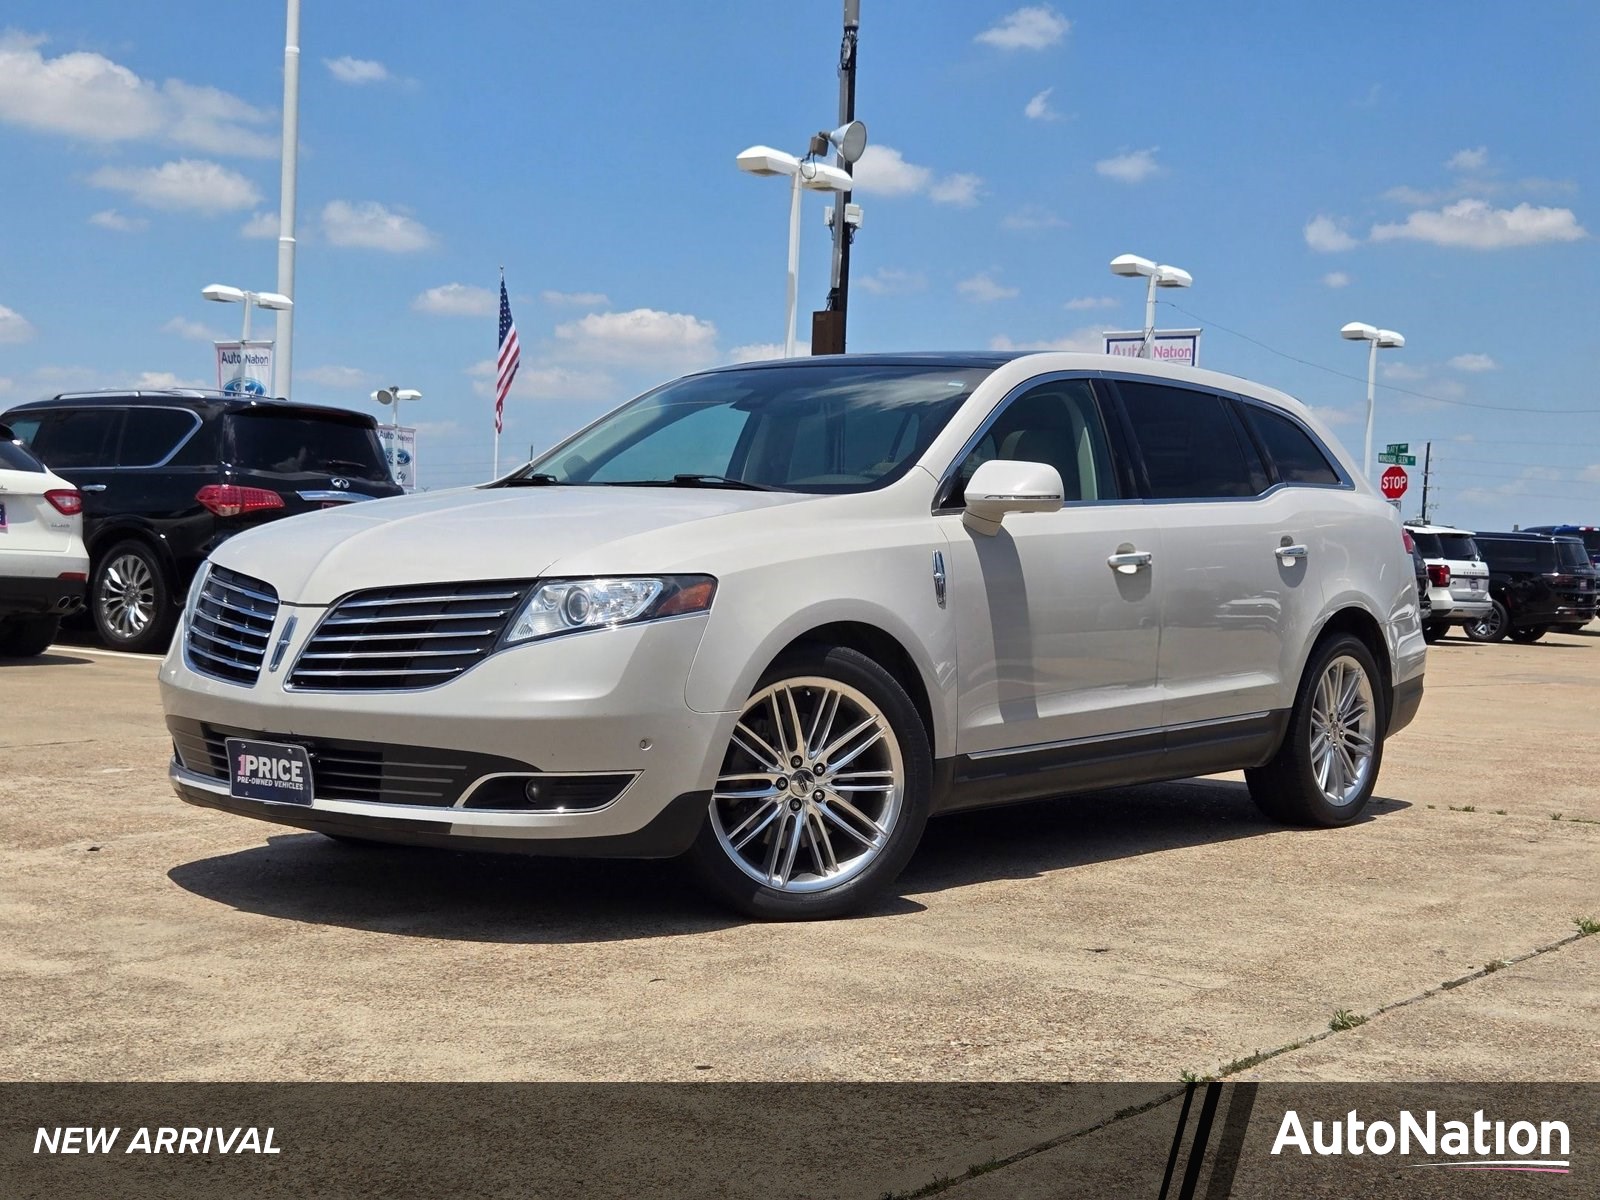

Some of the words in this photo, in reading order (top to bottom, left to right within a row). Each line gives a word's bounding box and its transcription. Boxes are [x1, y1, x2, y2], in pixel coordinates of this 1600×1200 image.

[1382, 476, 1407, 490] STOP
[237, 754, 304, 783] 1PRICE
[237, 776, 273, 787] PRE-OWNED
[274, 780, 304, 791] VEHICLES
